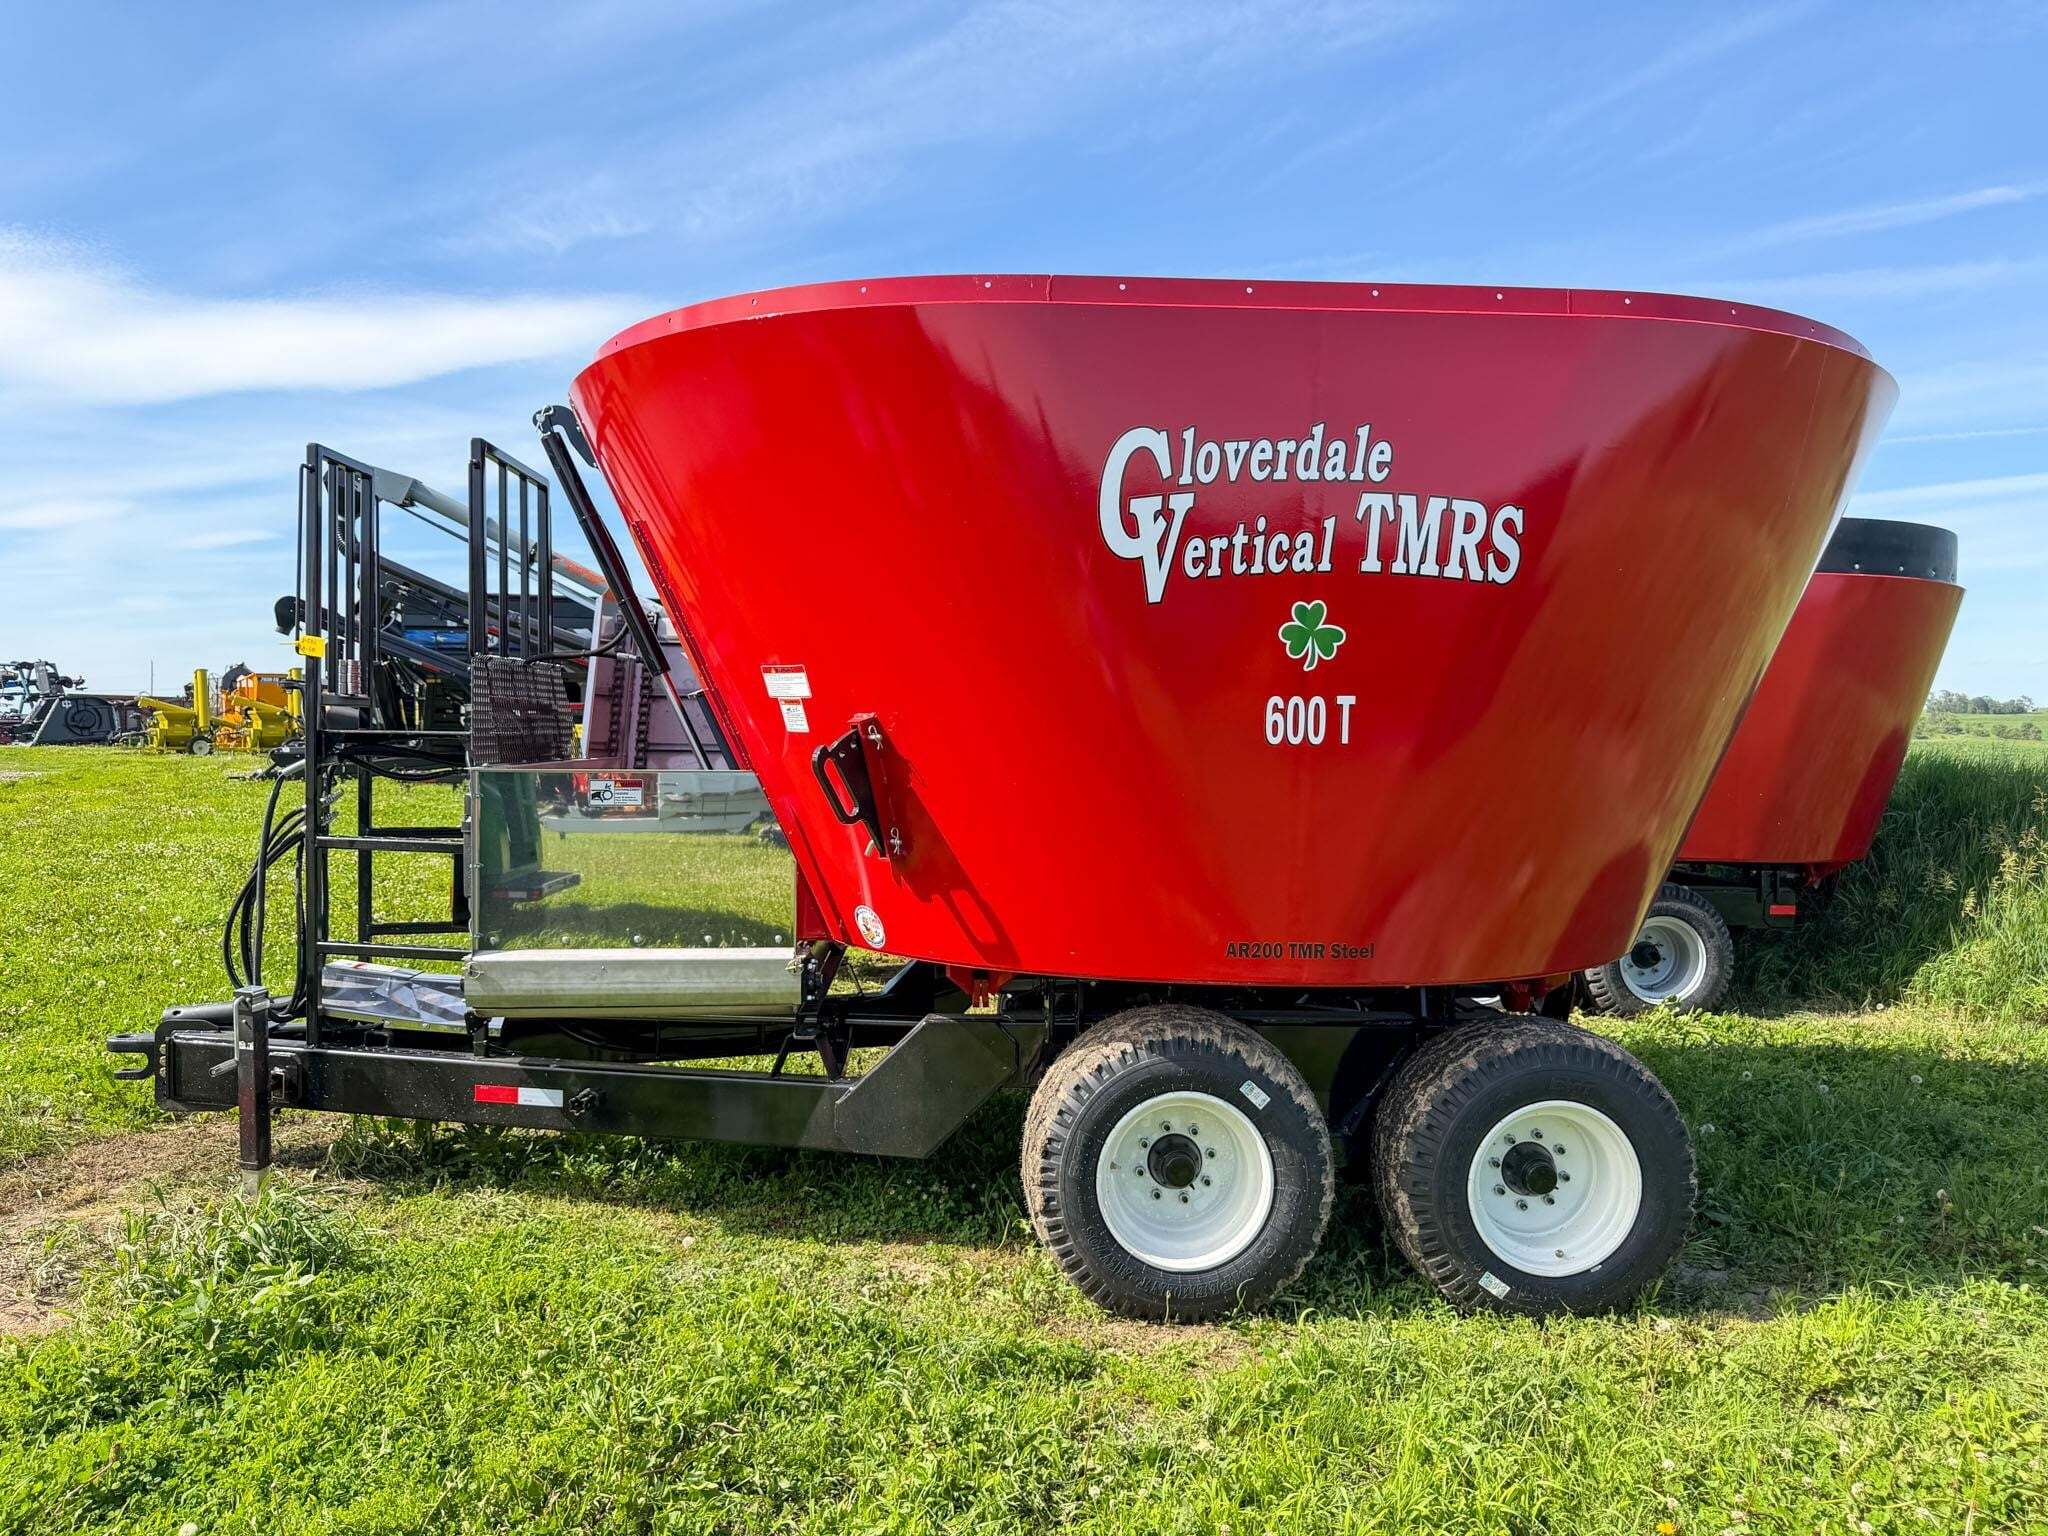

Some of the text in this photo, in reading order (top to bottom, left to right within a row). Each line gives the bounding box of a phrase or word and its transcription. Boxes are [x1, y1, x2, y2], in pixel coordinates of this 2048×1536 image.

[1099, 422, 1393, 560] Cloverdale
[1129, 492, 1524, 604] Vertical TMRS
[1265, 695, 1356, 745] 600 T
[1226, 942, 1375, 959] AR200 TMR Steel
